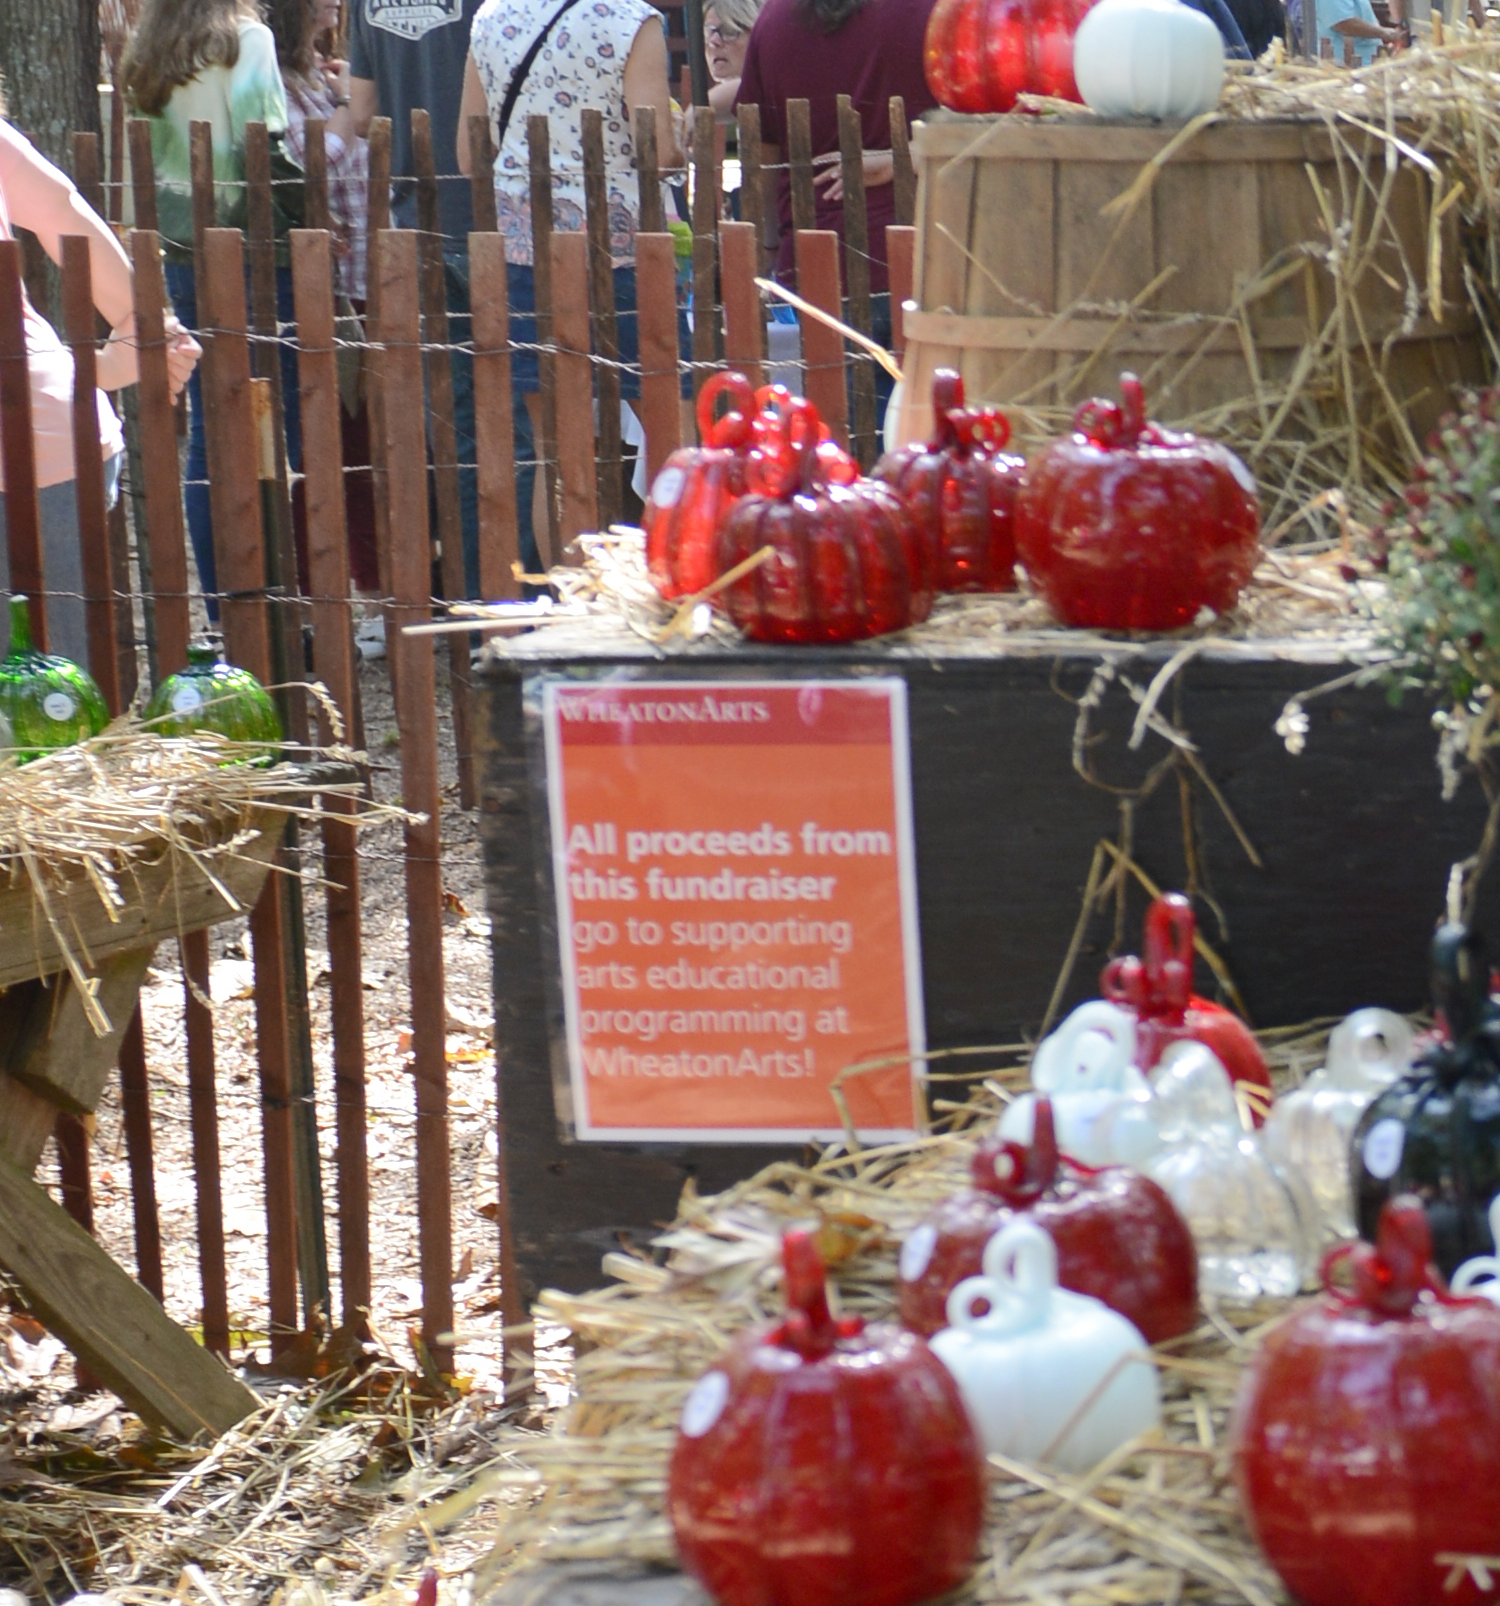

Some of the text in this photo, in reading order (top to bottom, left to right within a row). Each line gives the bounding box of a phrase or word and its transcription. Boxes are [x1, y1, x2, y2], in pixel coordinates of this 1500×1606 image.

[567, 822, 891, 861] All proceeds from
[568, 869, 835, 901] this fundraiser
[573, 915, 852, 953] go to supporting
[576, 959, 841, 990] arts educational
[580, 1005, 850, 1040] programming at
[583, 1047, 815, 1078] WheatonArts!
